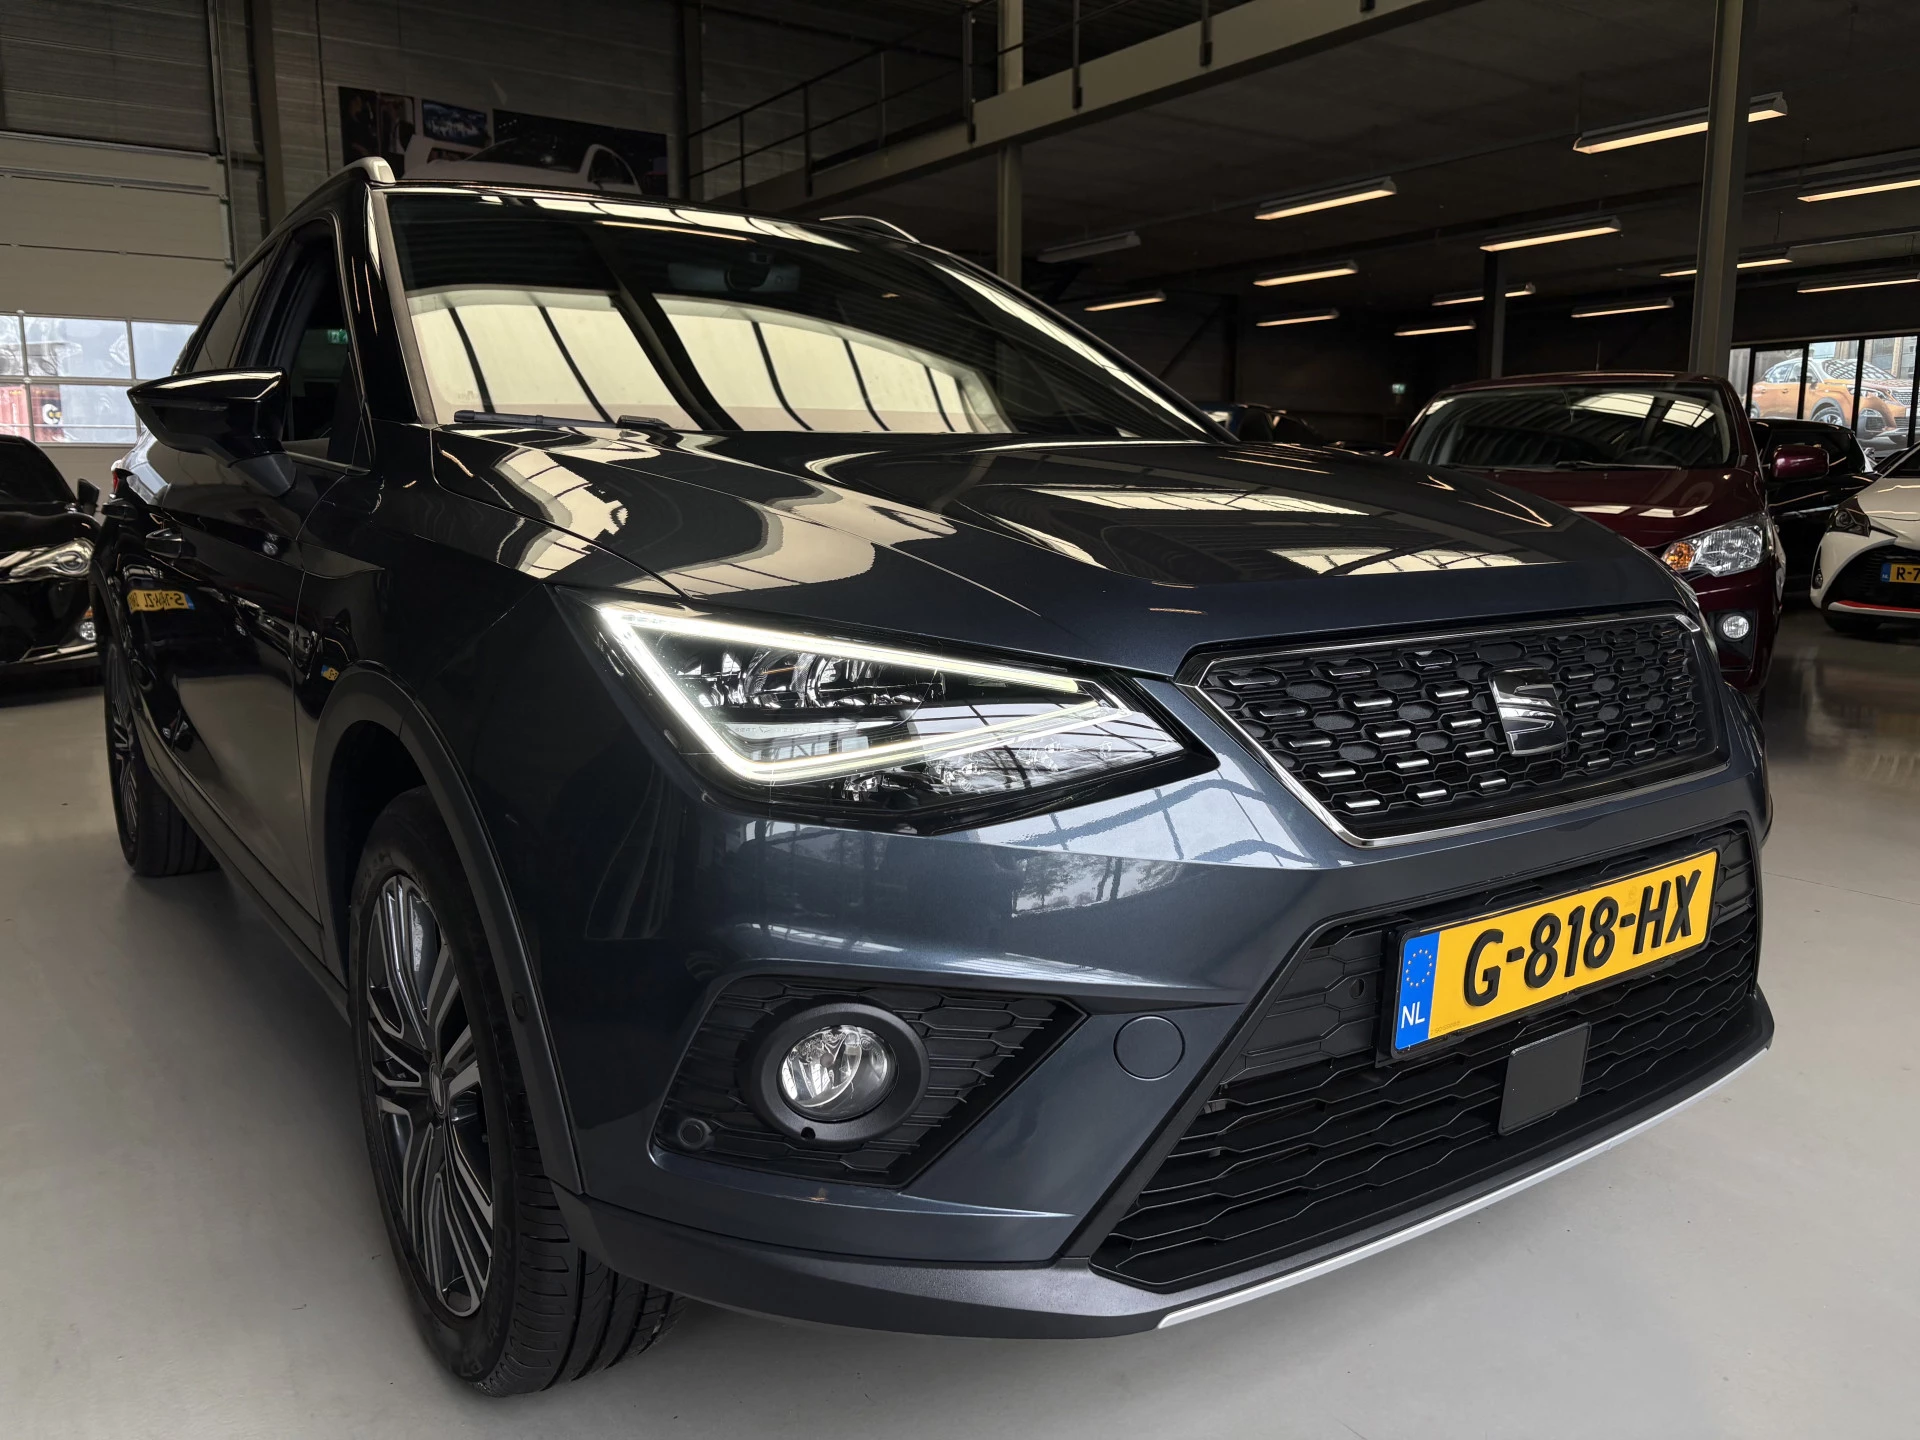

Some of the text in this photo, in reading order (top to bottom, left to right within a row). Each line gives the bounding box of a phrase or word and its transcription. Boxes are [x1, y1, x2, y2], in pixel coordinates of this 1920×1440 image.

[1896, 566, 1920, 582] R-7
[1463, 869, 1702, 1007] G-818-HX
[1400, 1001, 1425, 1029] NL
